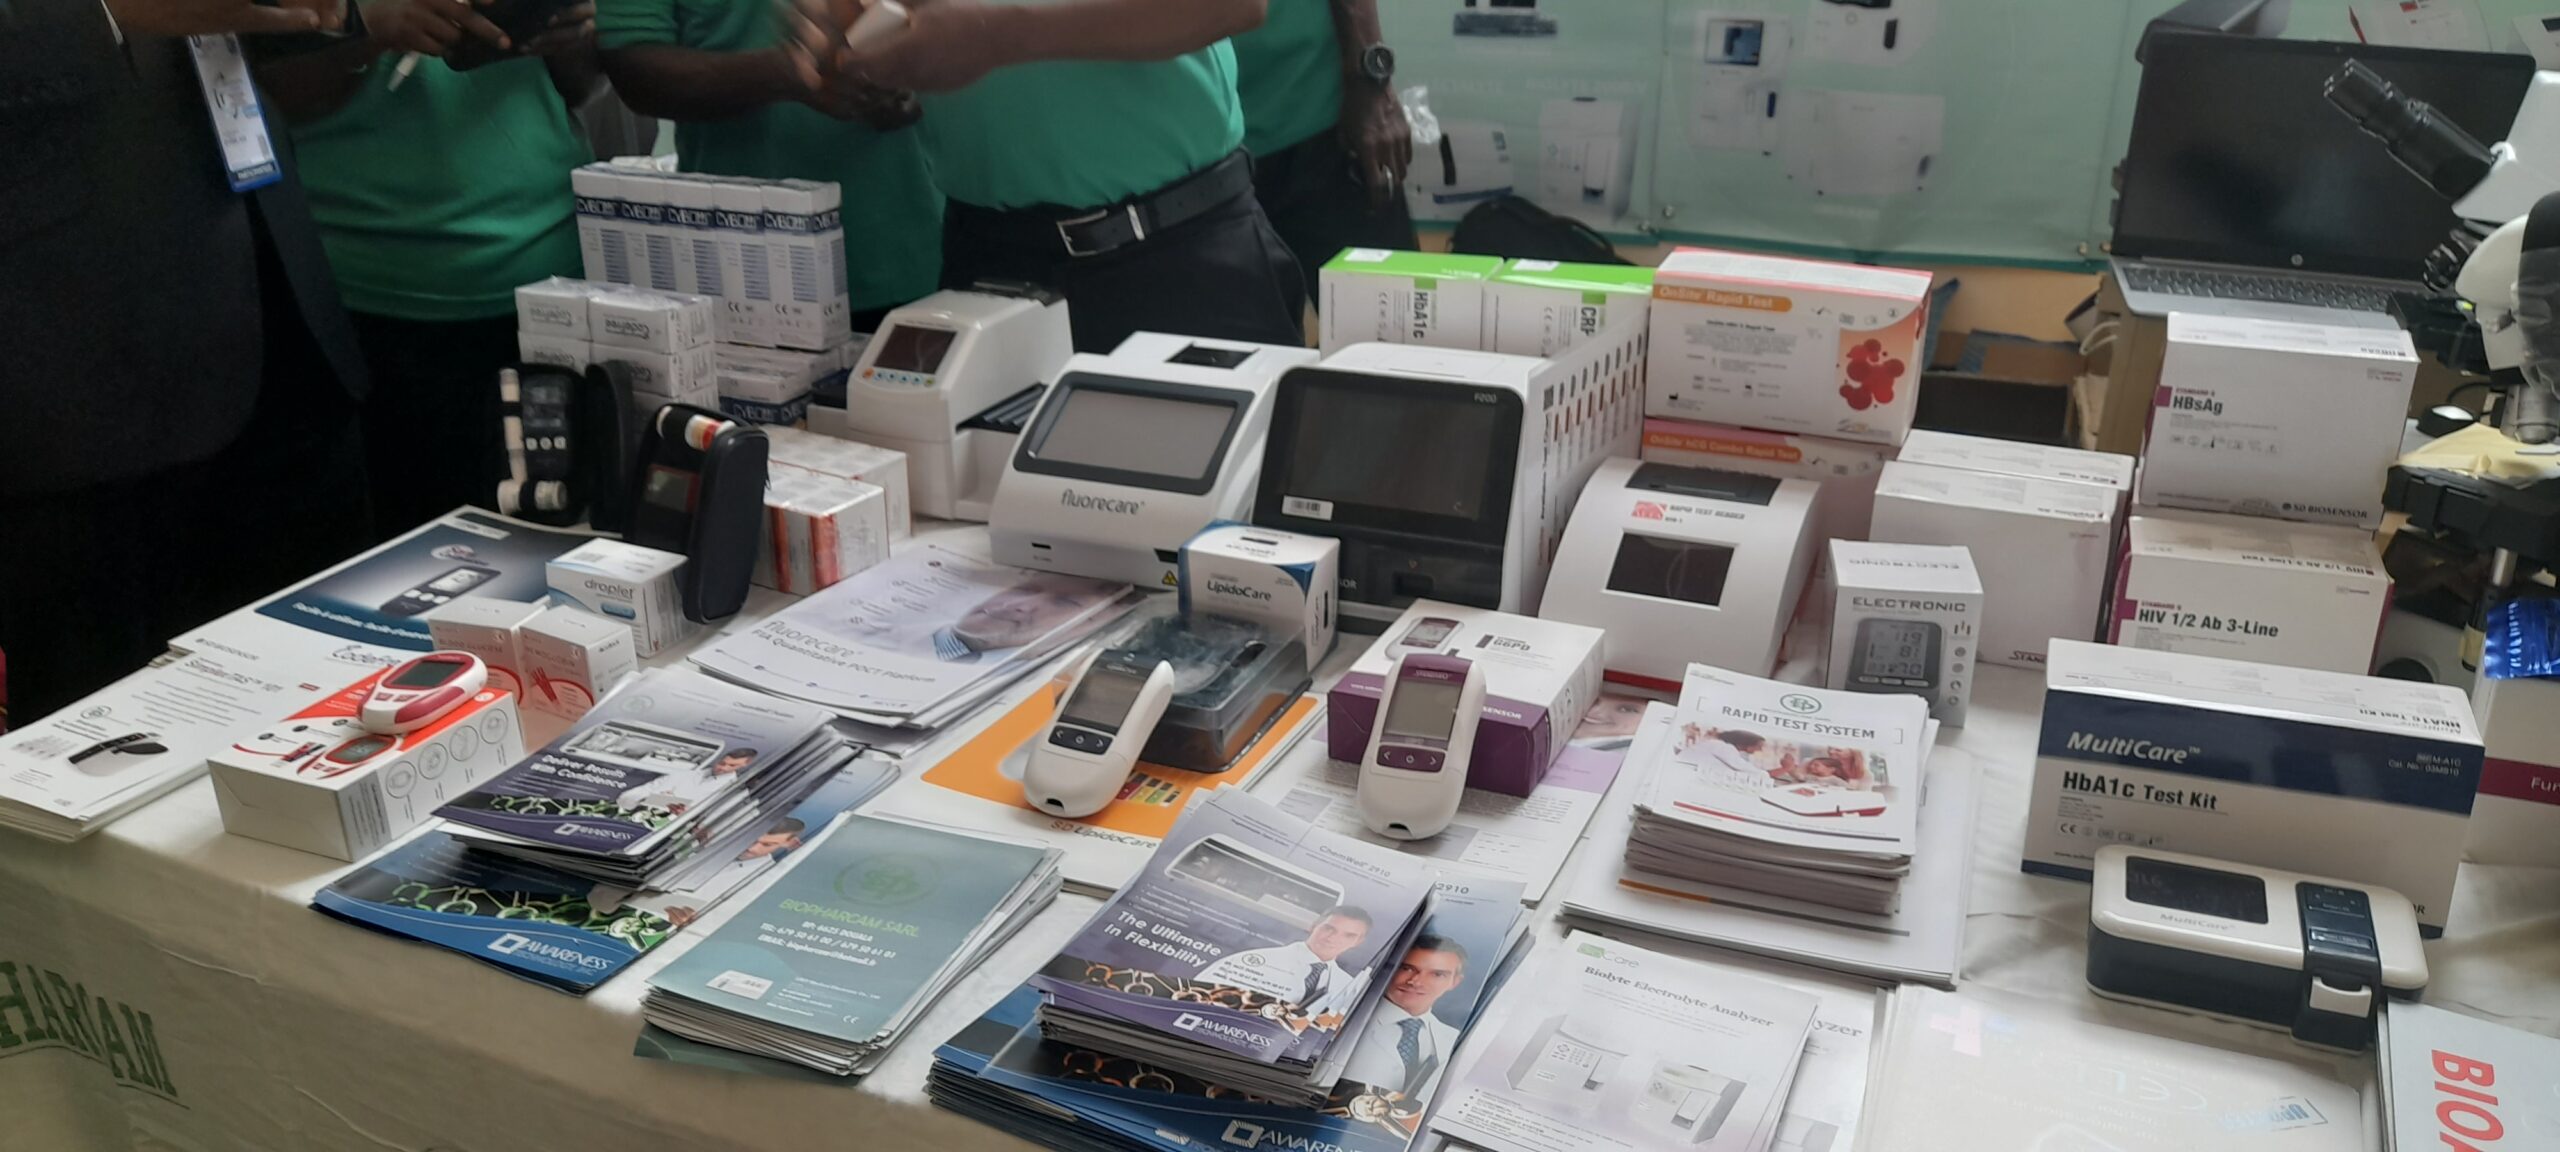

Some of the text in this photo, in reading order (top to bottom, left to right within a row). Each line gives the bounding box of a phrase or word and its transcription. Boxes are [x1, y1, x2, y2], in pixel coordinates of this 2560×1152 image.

[1705, 290, 1743, 306] Rapid
[1748, 294, 1773, 308] Test
[1413, 292, 1428, 339] HbA1c
[2172, 395, 2223, 415] HBsAg
[2307, 506, 2368, 520] BIOSENSOR
[584, 577, 635, 600] droplet
[1206, 579, 1272, 601] LipidoCare
[1852, 596, 1967, 613] ELECTRONIC
[2138, 608, 2279, 638] HIV 1/2 Ab 3-Line
[1721, 705, 1875, 739] RAPID TEST SYSTEM
[2062, 770, 2218, 810] HbA1c Test Kit
[1050, 818, 1072, 834] SD
[1073, 827, 1160, 851] LipidoCare
[1436, 882, 1471, 896] 2910
[778, 898, 921, 938] BIOPHARCAM SARL
[1104, 923, 1121, 938] In
[1124, 930, 1208, 969] Flexibility
[1117, 910, 1148, 930] The
[1150, 923, 1223, 957] Ultimate
[522, 940, 615, 970] AWARENESS
[1584, 965, 1632, 988] Biolyte
[1633, 978, 1709, 1010] Electrolyte
[1711, 1003, 1775, 1029] Analyzer
[1198, 1018, 1276, 1048] AWARENESS
